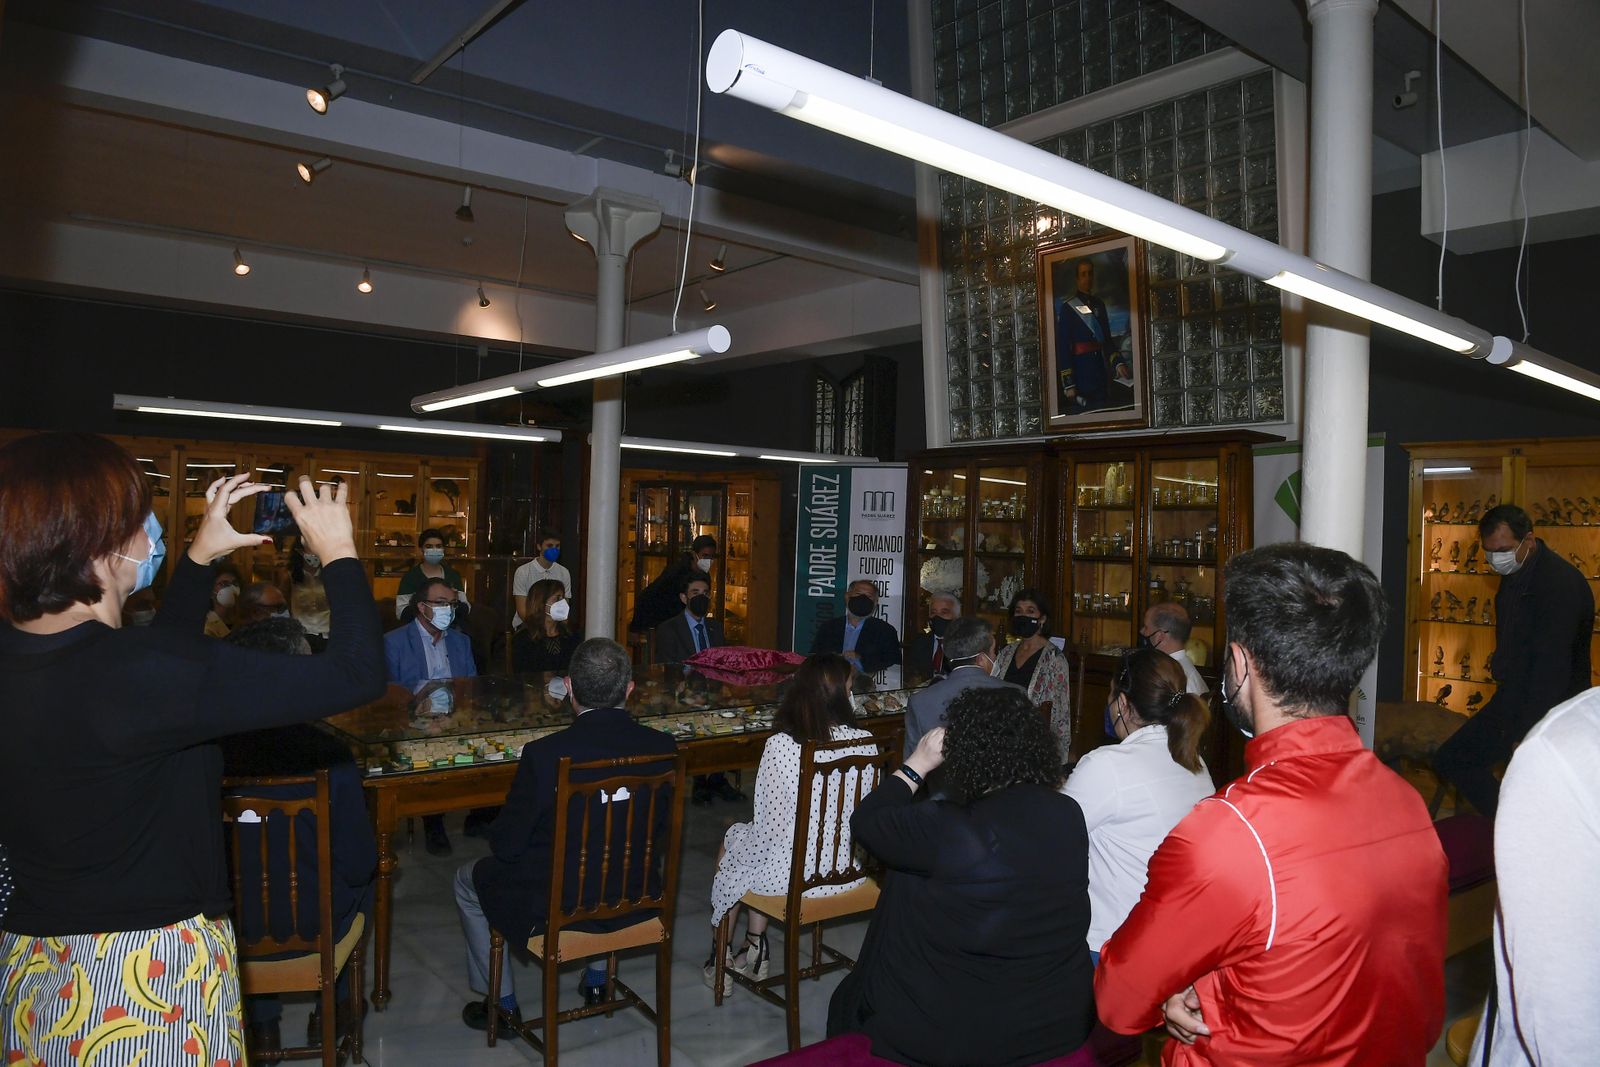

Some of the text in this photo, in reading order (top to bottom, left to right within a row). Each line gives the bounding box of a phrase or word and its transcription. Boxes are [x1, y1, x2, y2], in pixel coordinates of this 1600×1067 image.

[804, 473, 840, 539] SUÁREZ
[852, 534, 903, 553] FORMANDO
[808, 543, 838, 598] PADRE
[859, 557, 894, 576] FUTURO
